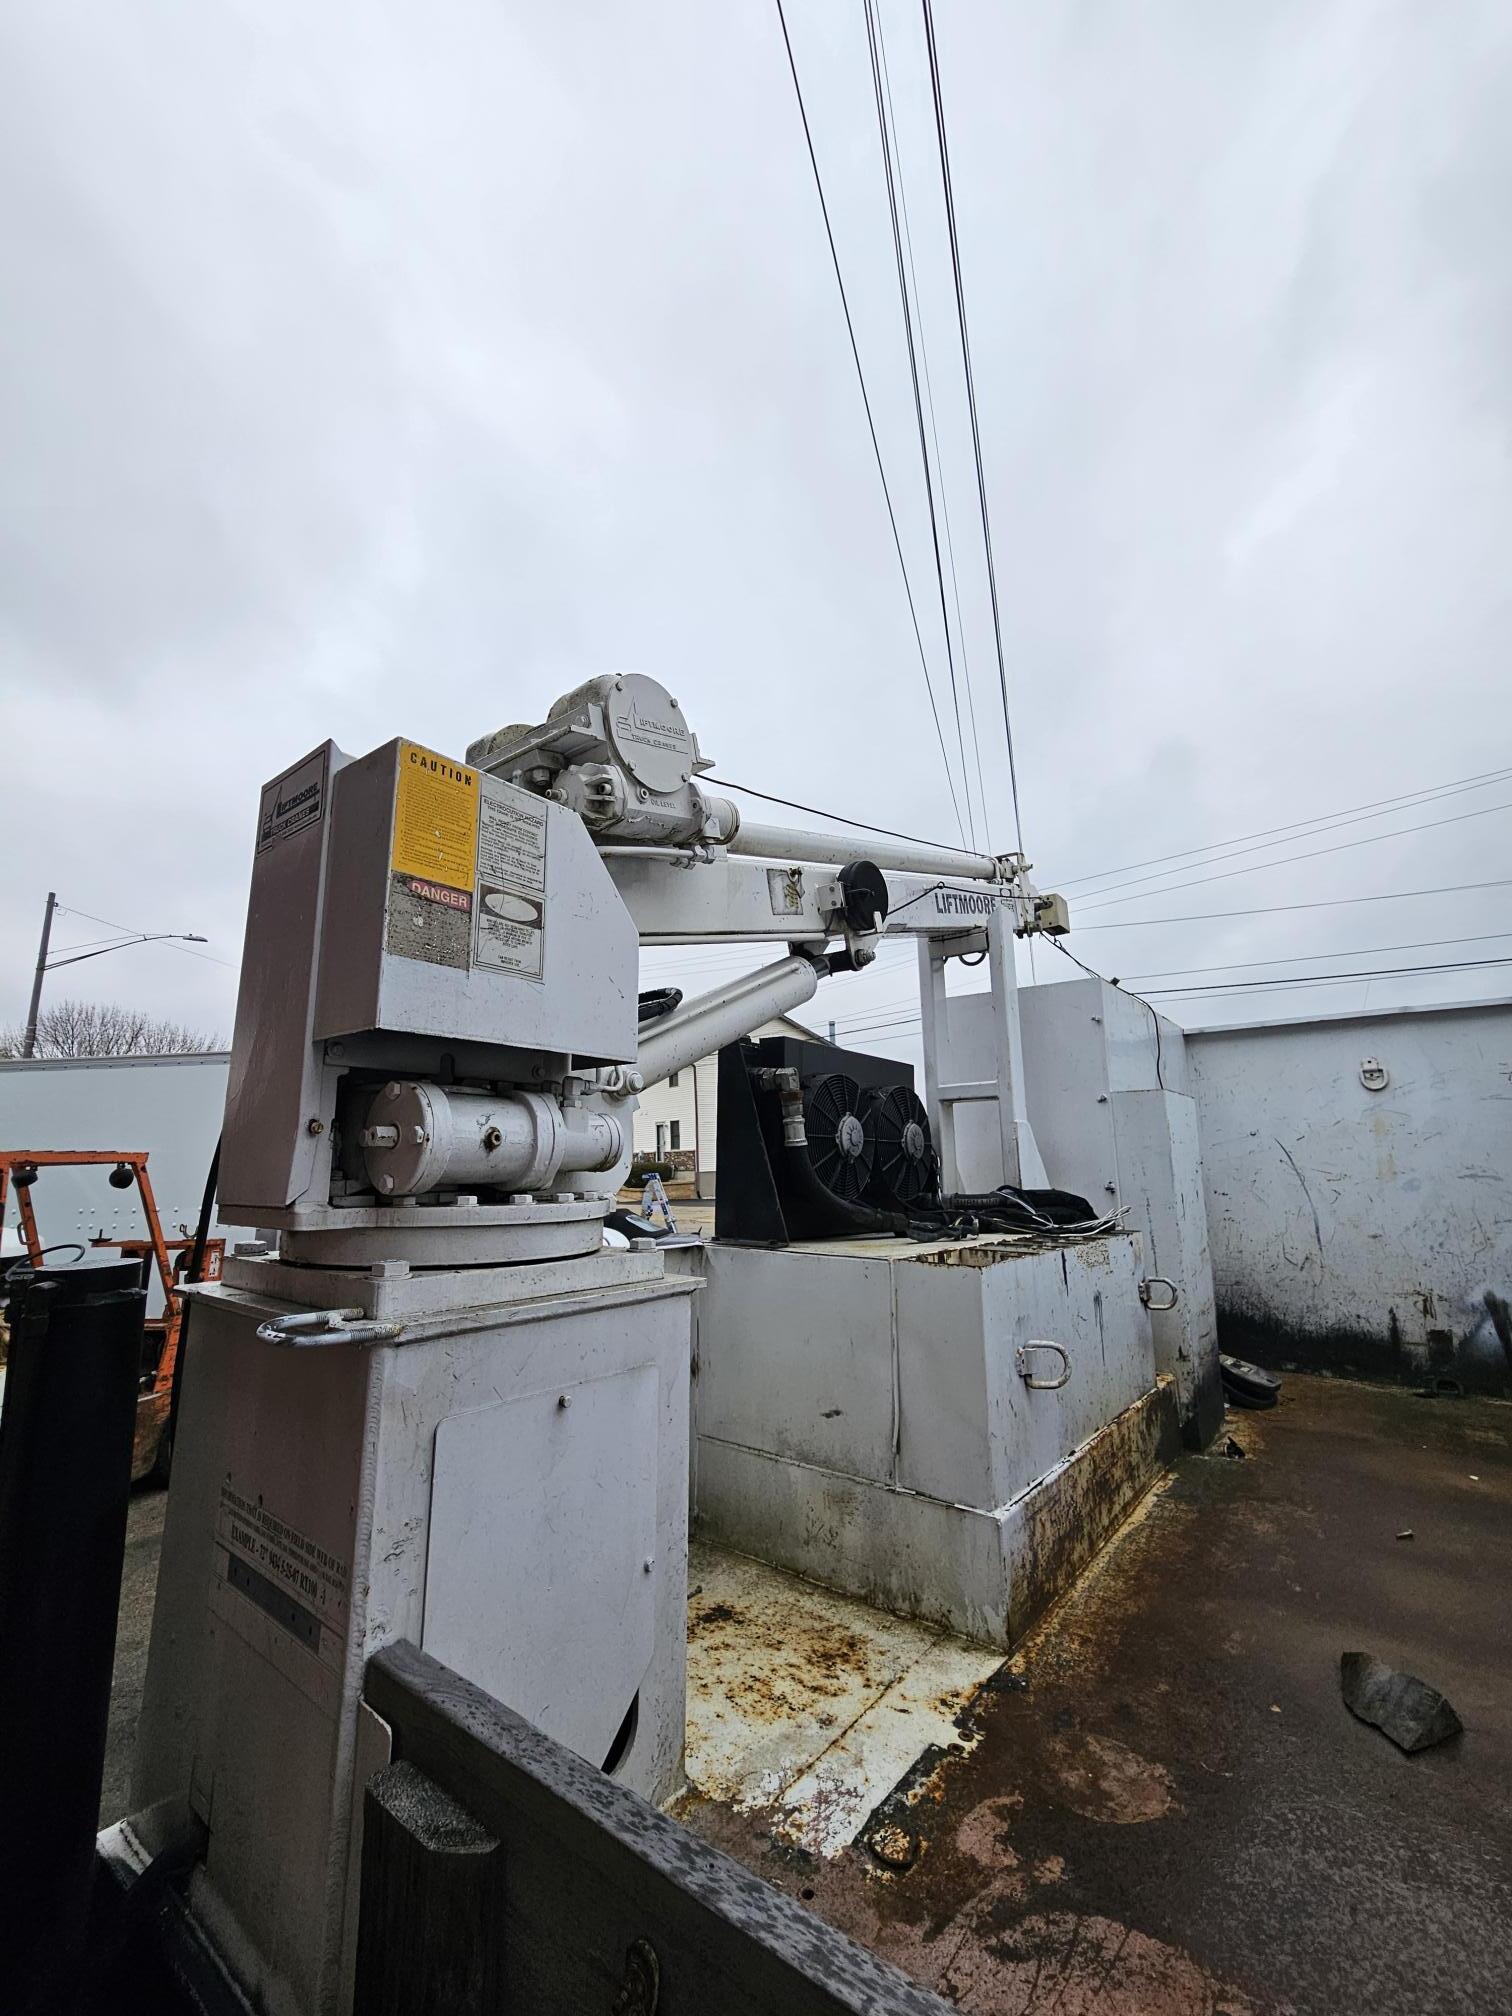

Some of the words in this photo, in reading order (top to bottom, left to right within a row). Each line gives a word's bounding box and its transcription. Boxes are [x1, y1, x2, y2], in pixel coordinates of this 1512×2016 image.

[632, 733, 651, 743] TRUCK
[653, 739, 676, 750] CRANES
[410, 752, 472, 786] CAUTION
[651, 799, 660, 807] OIL
[660, 800, 676, 809] LEVEL
[412, 882, 467, 908] DANGER
[934, 893, 996, 915] LIFTMOORE
[231, 1524, 257, 1555] EXAMPLE
[291, 1531, 305, 1551] FIELD
[317, 1548, 328, 1567] WEB
